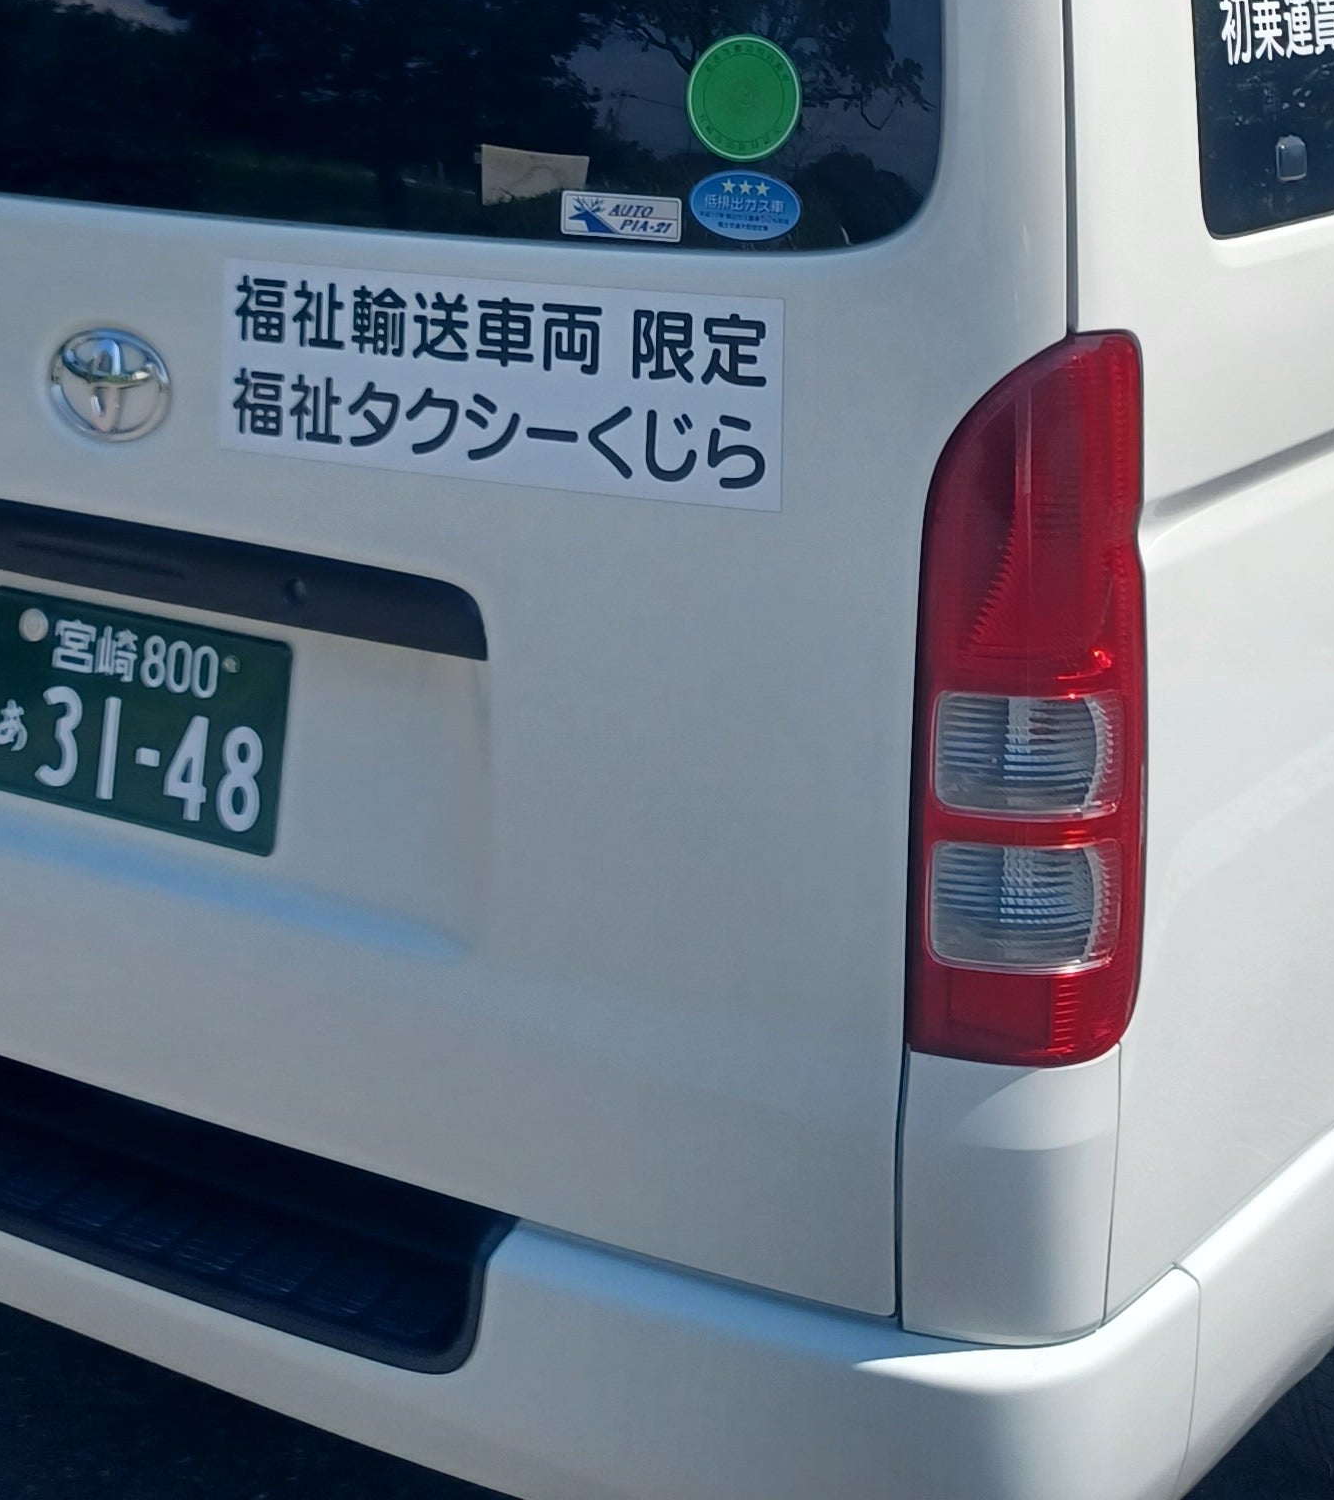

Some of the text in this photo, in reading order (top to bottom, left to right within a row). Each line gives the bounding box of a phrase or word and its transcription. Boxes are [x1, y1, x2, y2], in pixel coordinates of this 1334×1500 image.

[609, 204, 653, 218] AUTO
[231, 367, 766, 490] 福祉タクシーくじら
[34, 685, 264, 832] 31-48
